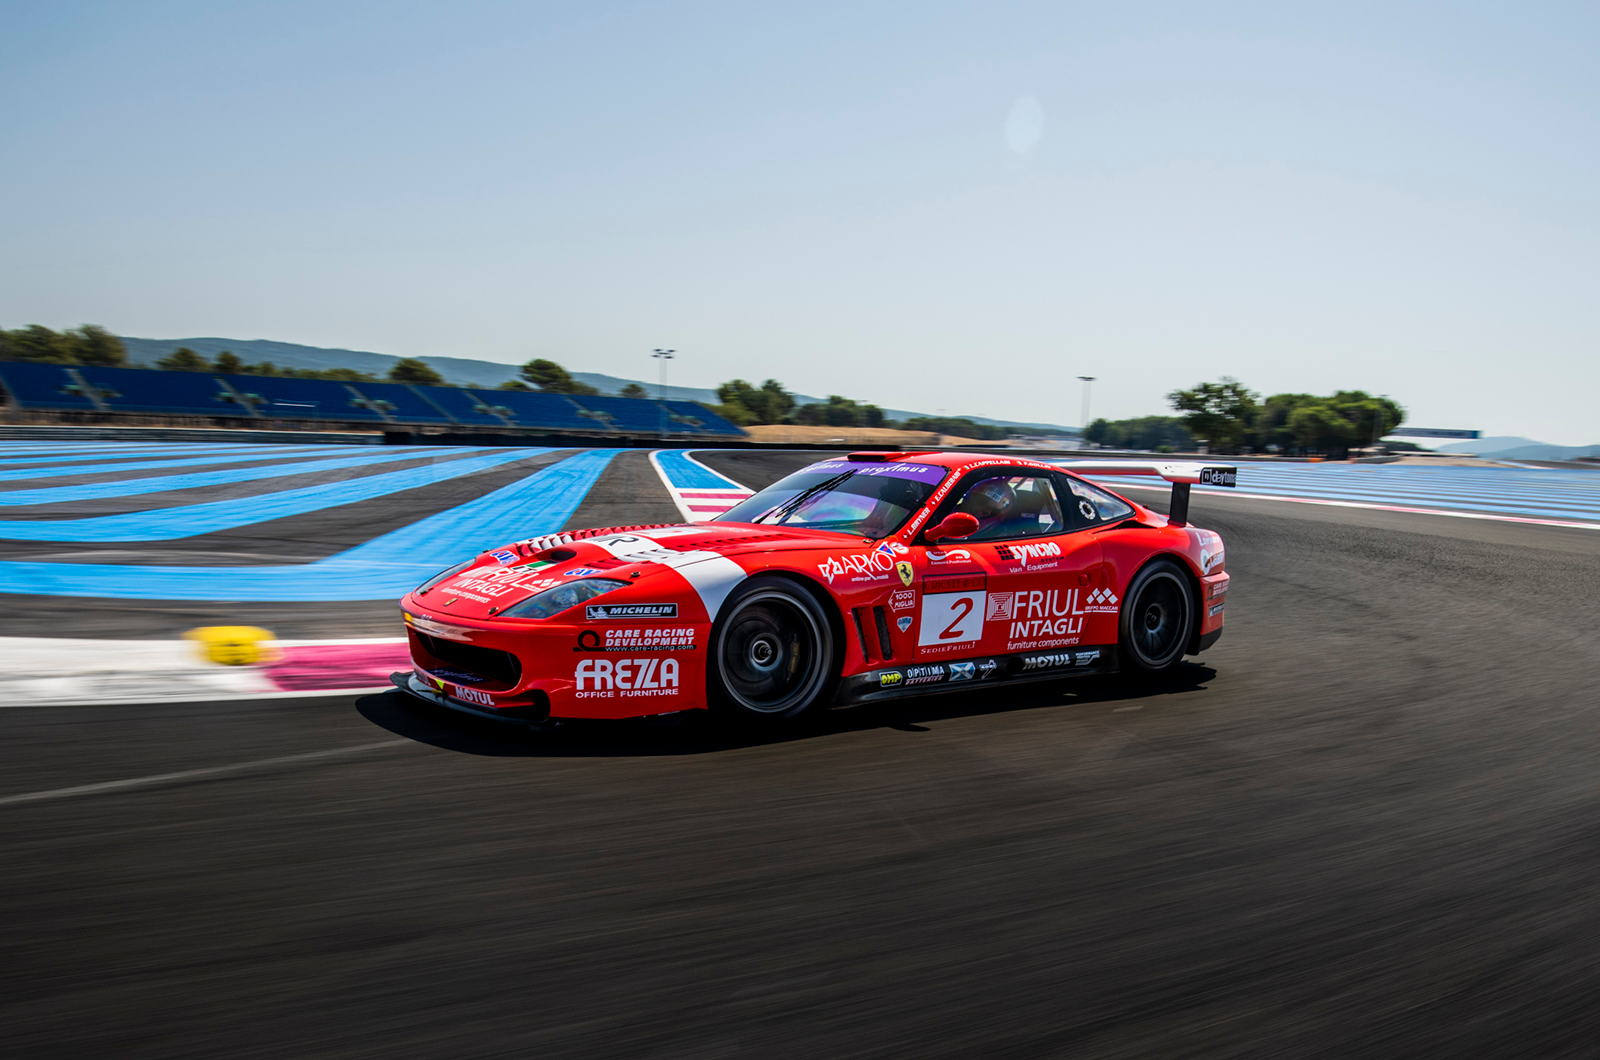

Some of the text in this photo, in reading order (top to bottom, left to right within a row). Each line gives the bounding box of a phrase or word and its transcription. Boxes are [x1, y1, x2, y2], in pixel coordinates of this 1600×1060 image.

[858, 463, 928, 476] proximus
[1008, 542, 1061, 567] SYNCRO
[842, 551, 893, 580] ARKO
[1027, 562, 1058, 571] Equipment
[452, 578, 514, 597] INTAGLI
[924, 579, 960, 590] CRICKET
[896, 592, 913, 600] 1000
[610, 606, 673, 615] MICHELIN
[894, 600, 914, 608] MIGLIA
[1013, 588, 1084, 619] FRIUL
[939, 597, 974, 640] 2
[605, 628, 694, 638] CARE RACING
[1009, 617, 1083, 639] INTAGLI
[605, 637, 694, 647] DEVELOPMENT
[605, 644, 694, 652] www.care-racing.com
[1007, 636, 1079, 651] furniture components
[1022, 654, 1071, 670] MOTUL
[574, 658, 679, 690] FREZZA
[907, 665, 945, 679] OPTIMA
[455, 686, 495, 706] MOTUL
[575, 688, 679, 698] OFFICE FURNITURE
